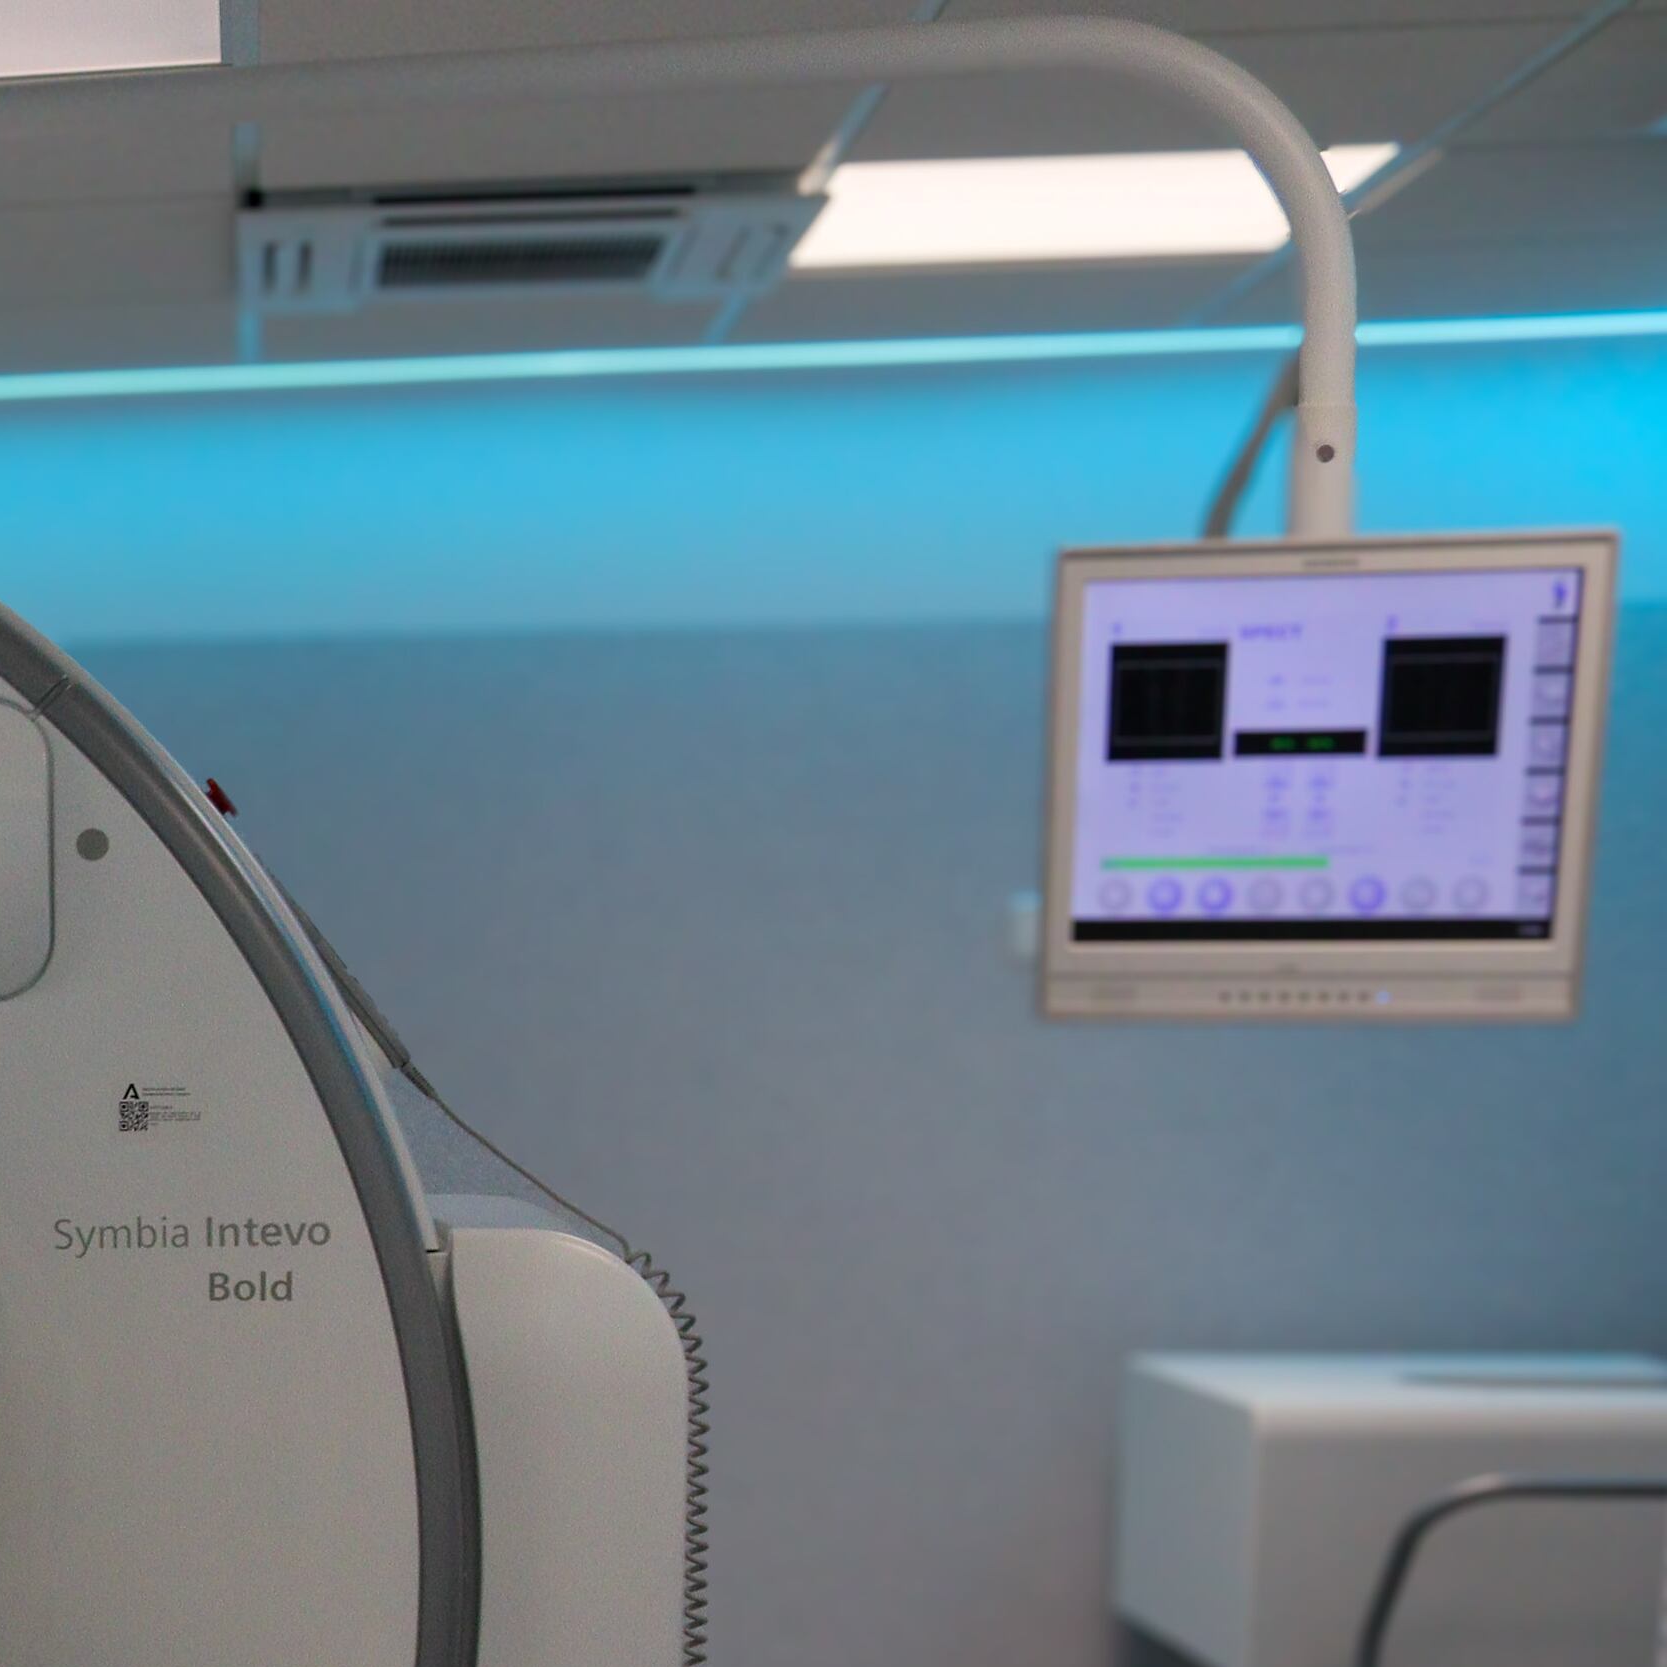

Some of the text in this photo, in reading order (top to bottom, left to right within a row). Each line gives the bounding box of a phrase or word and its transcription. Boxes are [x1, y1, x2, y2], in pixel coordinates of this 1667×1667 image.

[53, 1216, 332, 1259] Symbia Intevo
[208, 1270, 294, 1301] Bold
